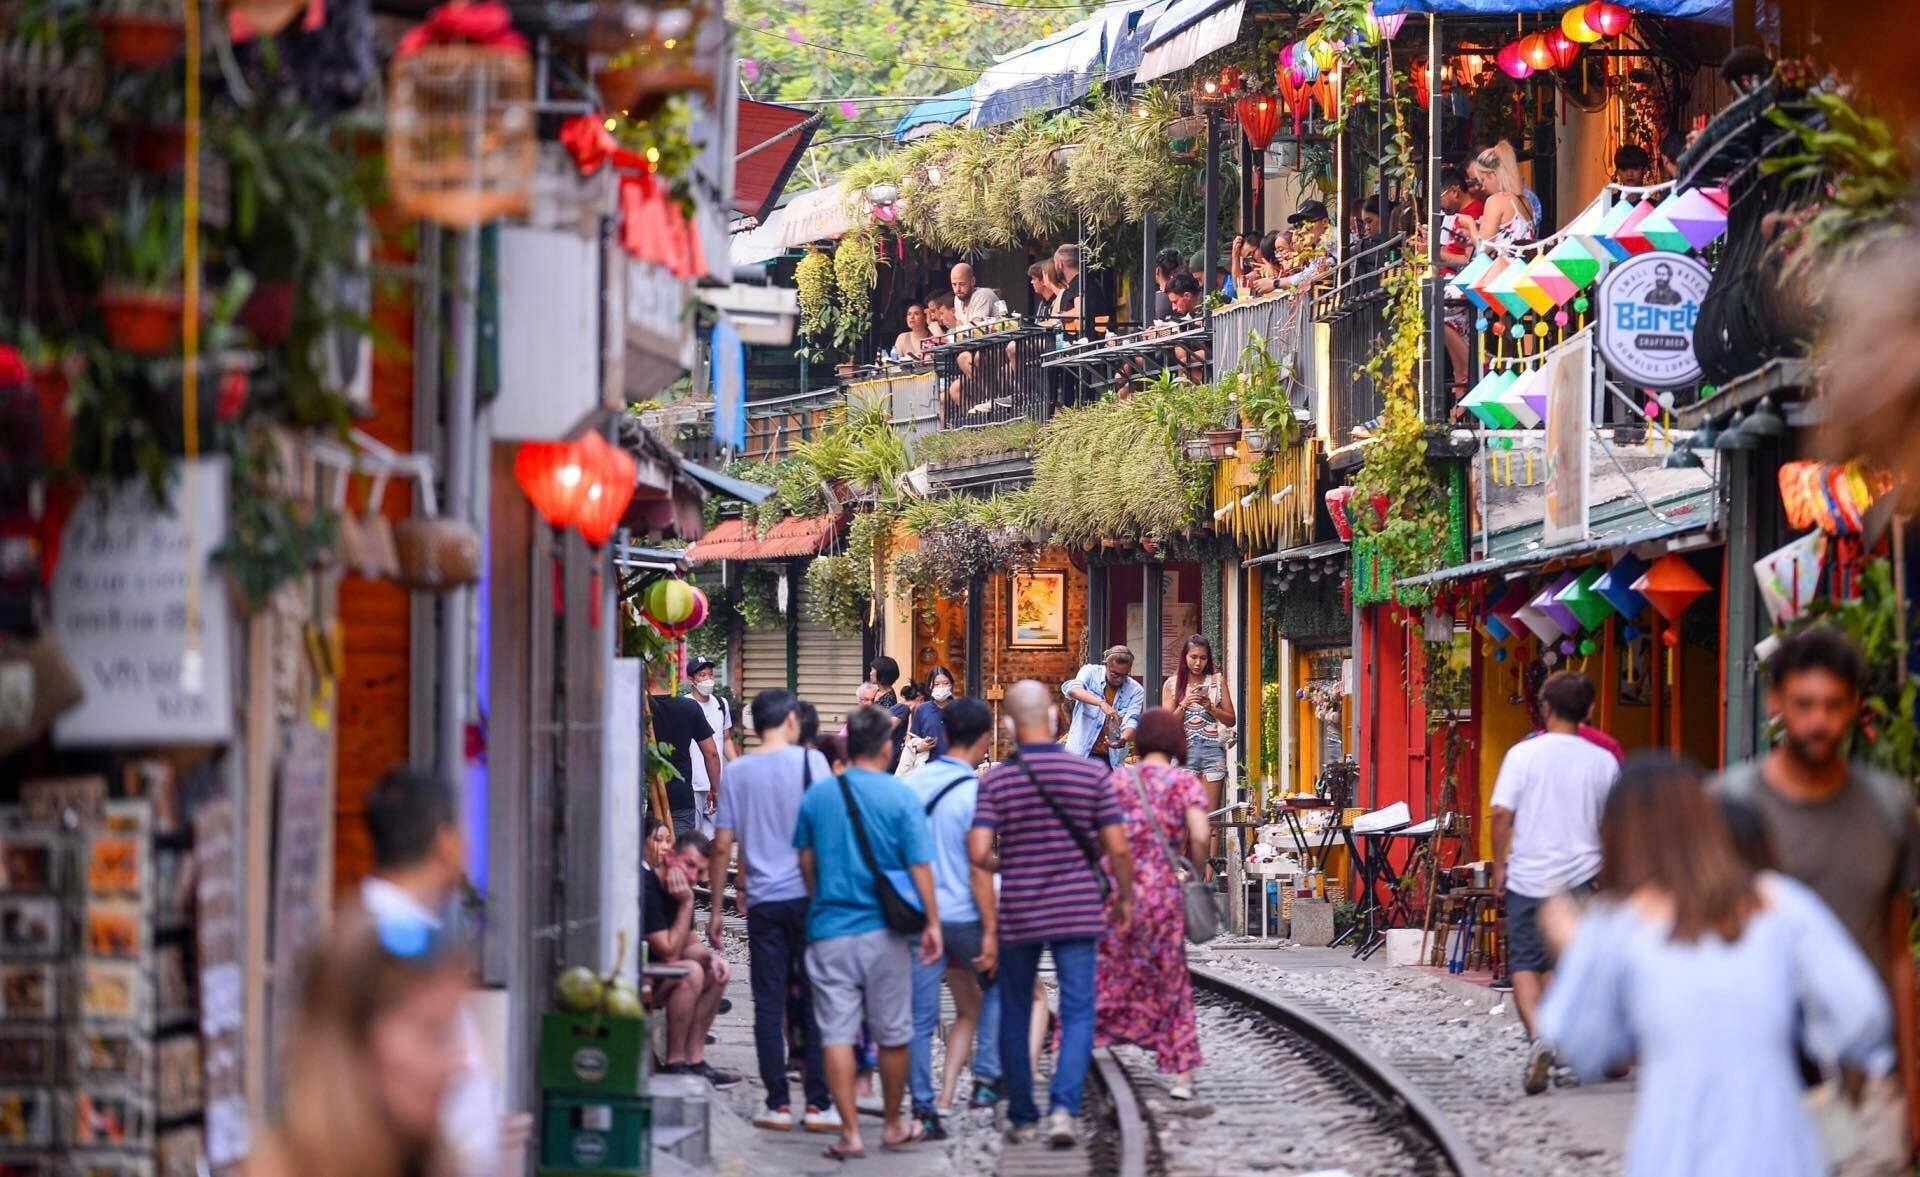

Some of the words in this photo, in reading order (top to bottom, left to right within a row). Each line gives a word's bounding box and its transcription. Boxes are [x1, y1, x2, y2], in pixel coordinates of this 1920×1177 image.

[1614, 300, 1699, 332] Baret
[1638, 338, 1664, 346] CRAFT
[1665, 338, 1685, 347] BEER
[1666, 356, 1694, 372] LUPU
